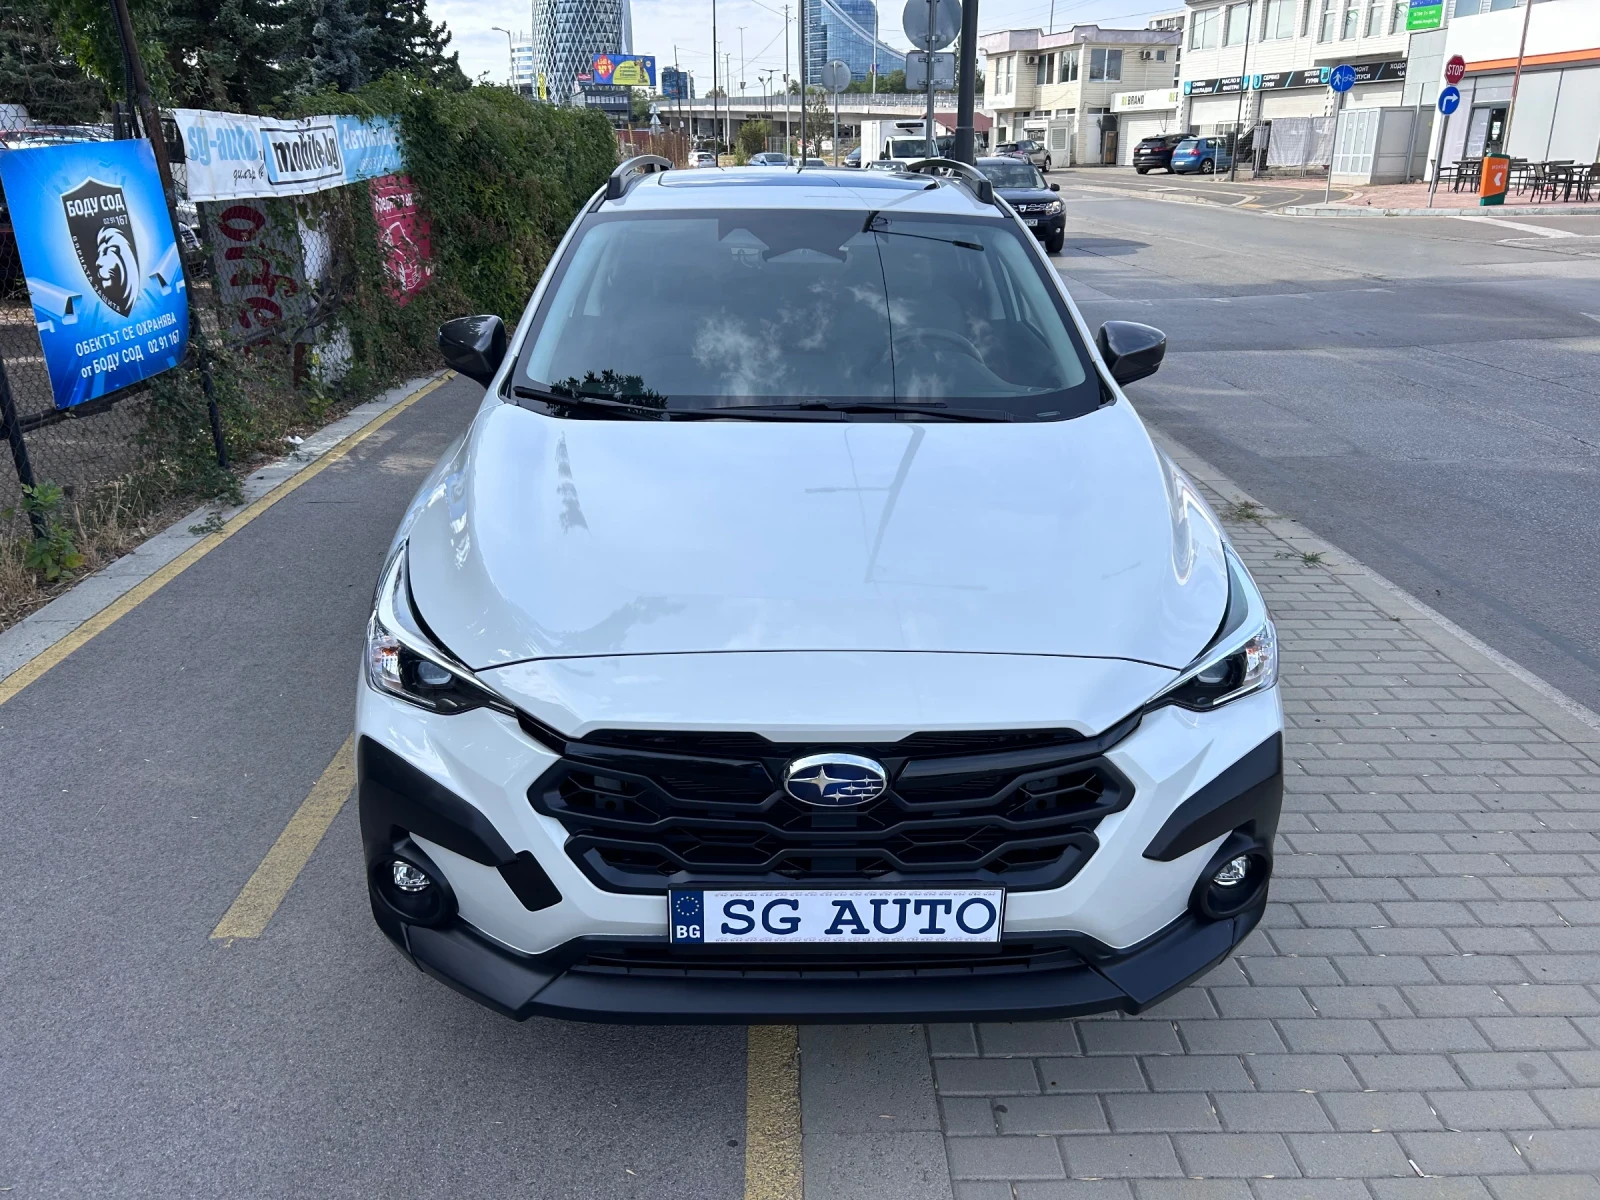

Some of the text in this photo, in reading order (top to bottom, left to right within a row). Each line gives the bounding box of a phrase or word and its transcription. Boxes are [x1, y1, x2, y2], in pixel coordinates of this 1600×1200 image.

[1447, 65, 1464, 76] STOP
[271, 132, 340, 173] mobile.bg
[66, 193, 125, 218] БОДУ СОД
[116, 214, 129, 226] 167
[75, 311, 177, 357] ОБЕКТЪТ СЕ ОХРАНЯВА
[81, 329, 181, 378] от БОДУ СОД 02 91 167
[676, 924, 701, 939] BG
[720, 897, 997, 935] SG AUTO
